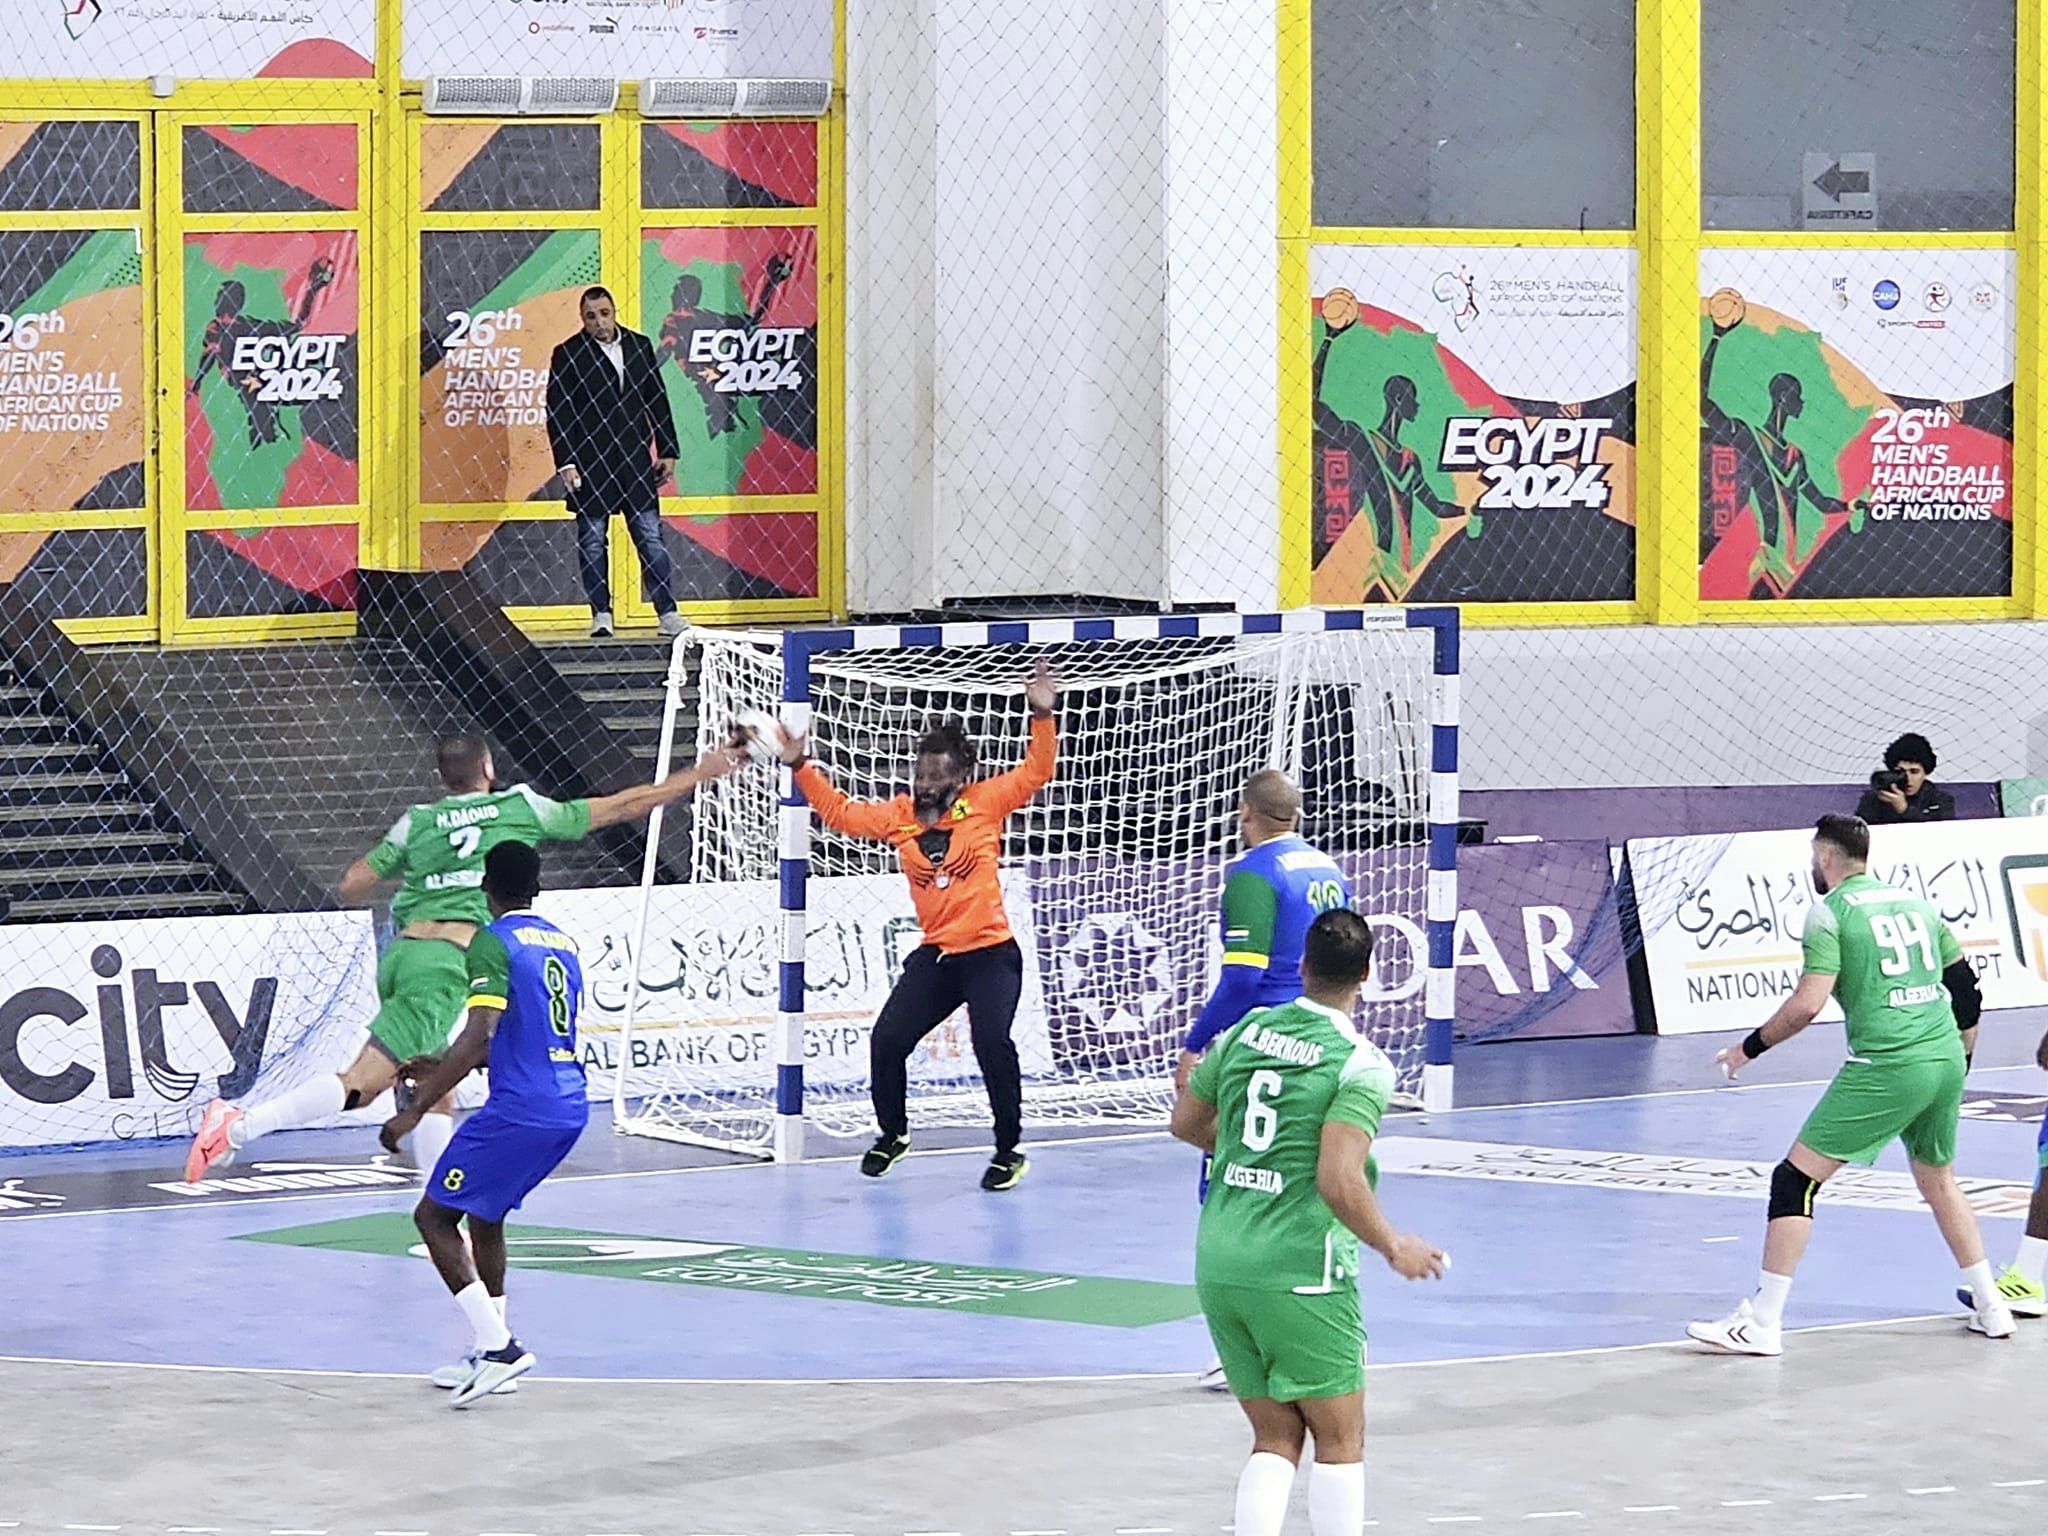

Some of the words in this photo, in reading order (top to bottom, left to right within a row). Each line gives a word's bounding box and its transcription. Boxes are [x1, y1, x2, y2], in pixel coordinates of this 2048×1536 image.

[442, 307, 522, 348] 26th
[232, 335, 346, 371] EGYPT
[444, 347, 522, 369] MEN'S
[688, 328, 804, 364] EGYPT
[257, 368, 344, 401] 2024
[444, 369, 550, 391] HANDBA
[714, 361, 803, 393] 2024
[80, 394, 123, 413] CUP
[442, 390, 533, 408] AFRICAN
[0, 415, 18, 433] F
[21, 413, 111, 432] NATIONS
[445, 409, 475, 427] OF
[477, 407, 547, 426] NATION
[1870, 406, 1950, 444] 26th
[1441, 417, 1613, 465] EGYPT
[1871, 444, 1948, 465] MEN'S
[1479, 464, 1608, 508] 2024
[1871, 465, 2004, 487] HANDBALL
[1869, 486, 1960, 503] AFRICAN
[1962, 486, 2006, 503] CUP
[1871, 504, 1902, 521] OF
[1903, 504, 1993, 521] NATIONS
[450, 826, 482, 859] 7
[1868, 911, 1936, 977] 94
[544, 955, 570, 1037] 8
[0, 944, 278, 1104] city
[631, 1034, 718, 1068] BANK
[1241, 1069, 1283, 1152] 6
[443, 1168, 465, 1191] 8
[641, 1267, 832, 1289] EGYPT
[826, 1284, 990, 1305] POST
